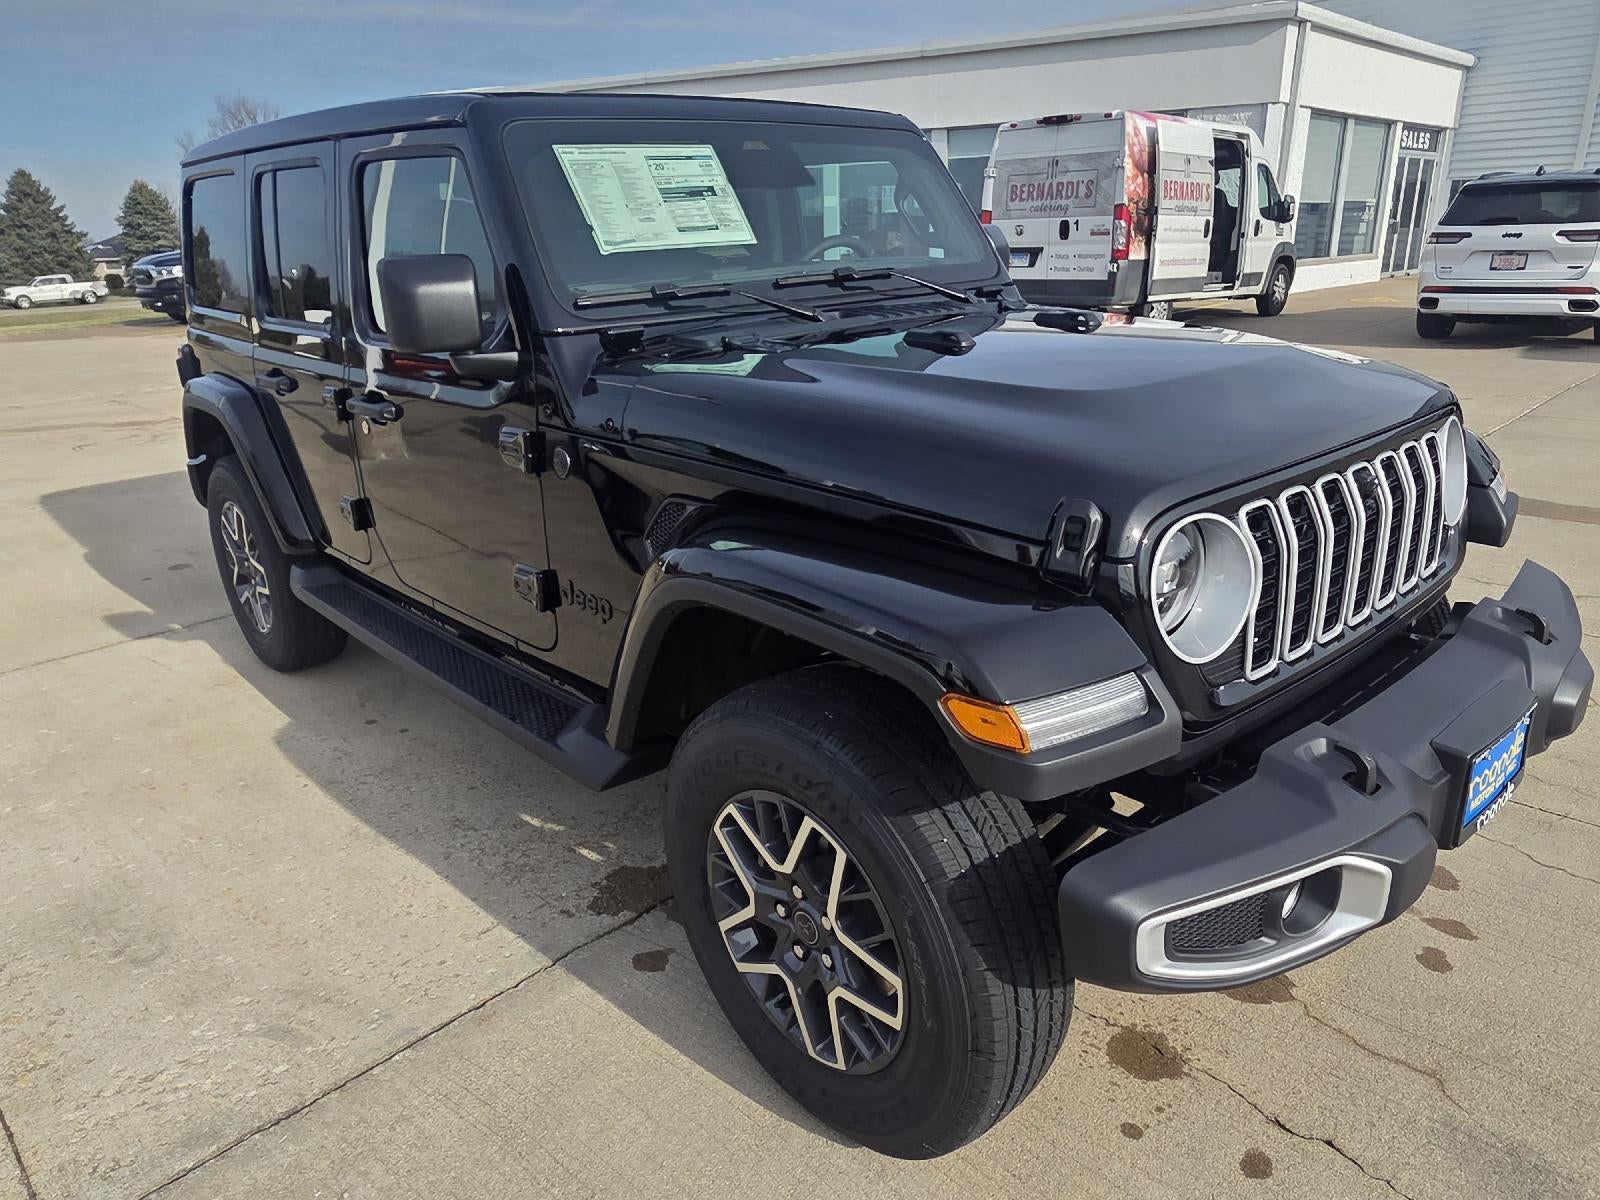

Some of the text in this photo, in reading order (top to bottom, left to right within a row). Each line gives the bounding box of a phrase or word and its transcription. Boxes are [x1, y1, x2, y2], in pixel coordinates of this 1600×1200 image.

[1401, 129, 1431, 150] SALES
[1010, 179, 1095, 202] BERNARDI'S
[1163, 180, 1211, 202] BERNARDI'S
[1029, 202, 1071, 215] catering
[1174, 202, 1199, 216] catering
[1073, 218, 1080, 232] 1
[561, 579, 614, 624] Jeep
